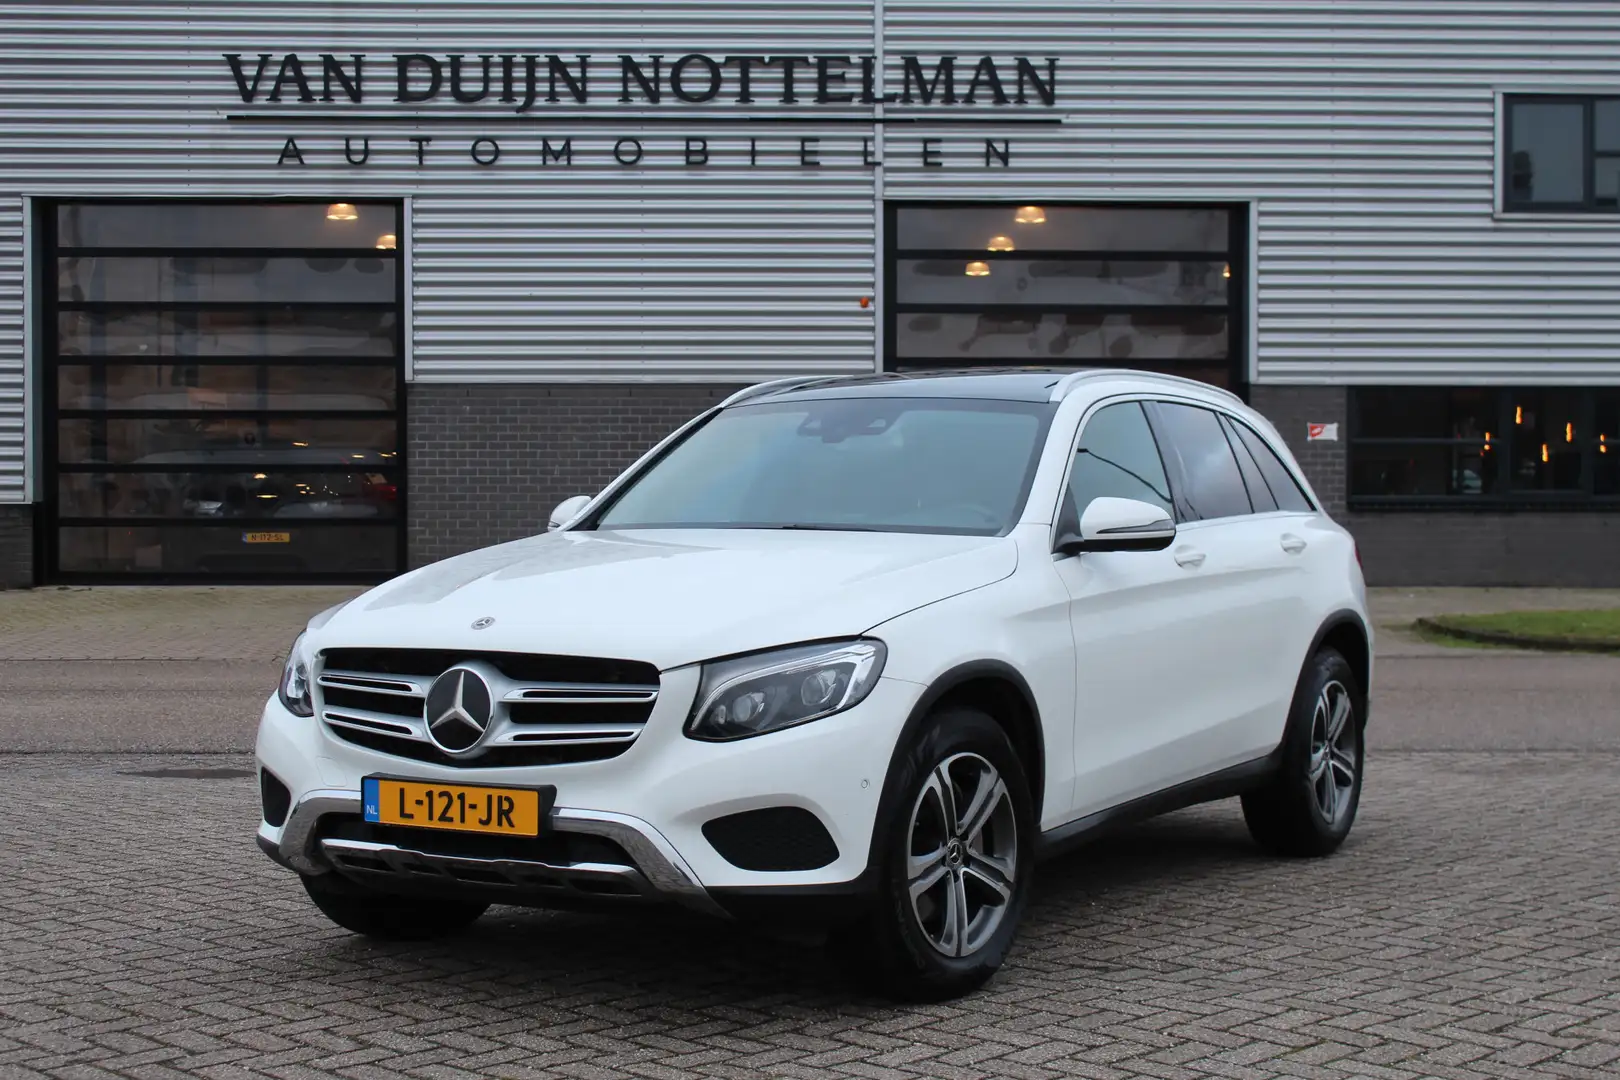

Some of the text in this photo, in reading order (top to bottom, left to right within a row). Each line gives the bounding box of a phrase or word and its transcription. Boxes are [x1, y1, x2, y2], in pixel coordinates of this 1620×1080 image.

[222, 53, 1060, 114] VAN DUIJN NOTTELMAN
[277, 136, 1009, 167] AUTOMOBIELEN
[366, 787, 515, 828] NL L-121-JR
